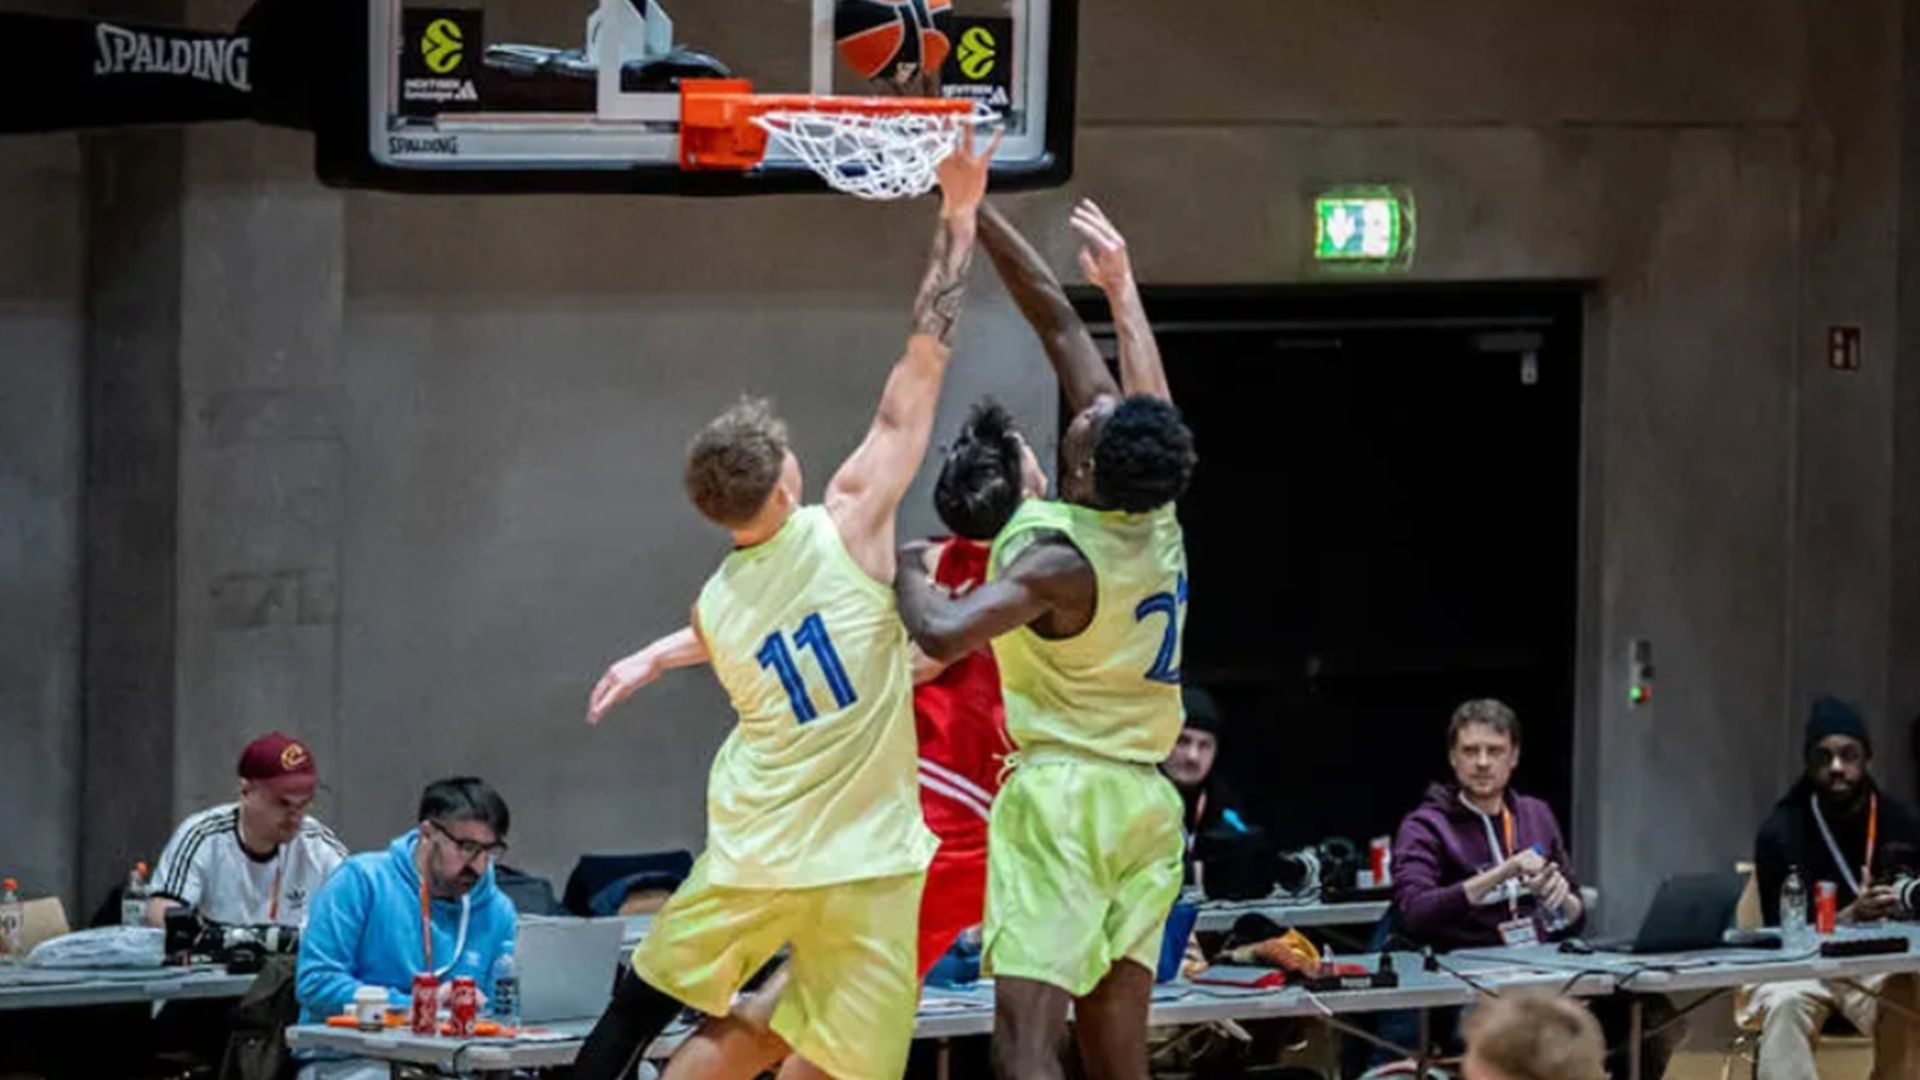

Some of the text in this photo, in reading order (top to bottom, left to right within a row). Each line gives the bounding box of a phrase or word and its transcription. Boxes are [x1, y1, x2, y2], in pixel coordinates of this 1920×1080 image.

[95, 23, 251, 91] SPALDING
[388, 136, 458, 155] SPALDING
[756, 612, 858, 724] 11
